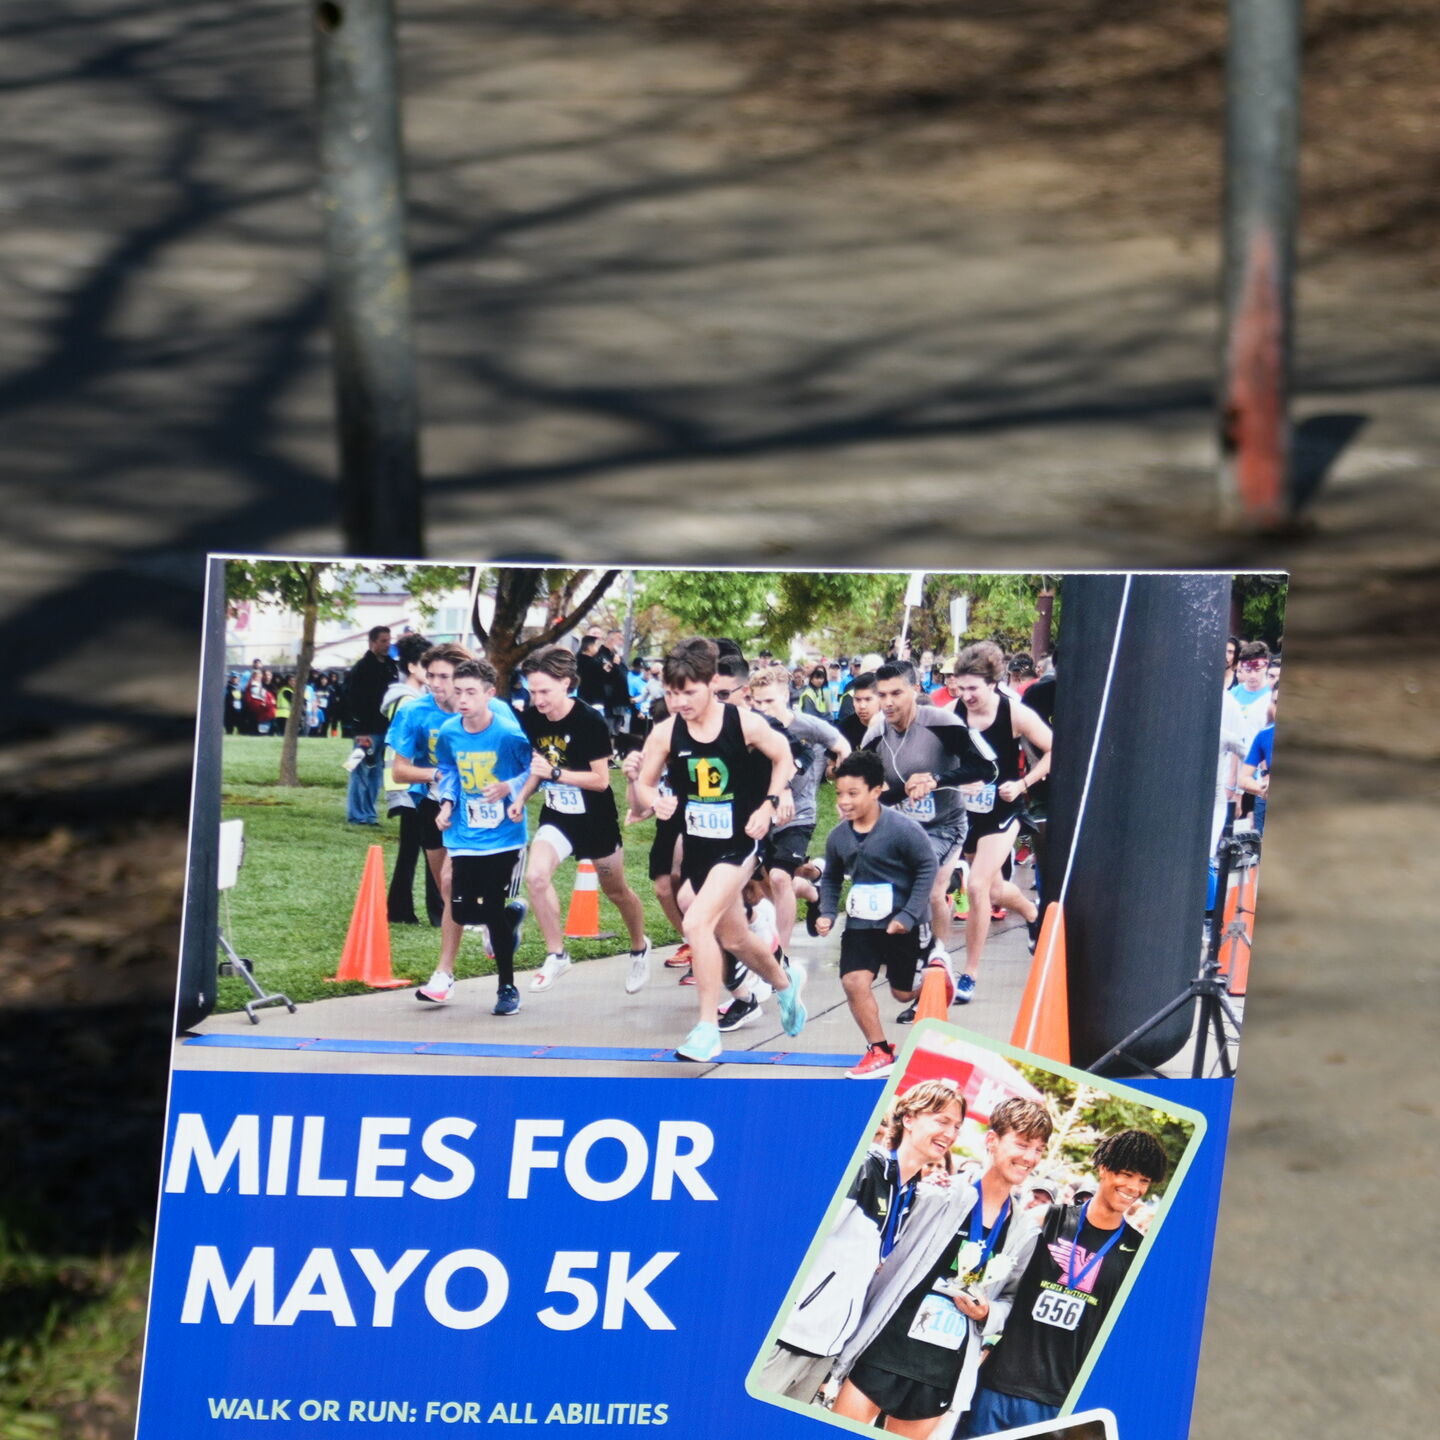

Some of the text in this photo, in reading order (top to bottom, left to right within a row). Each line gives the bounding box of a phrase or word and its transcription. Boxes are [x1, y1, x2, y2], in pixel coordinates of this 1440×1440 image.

[480, 804, 498, 819] 55
[560, 791, 578, 805] 53
[698, 813, 729, 829] 100
[164, 1112, 718, 1201] MILES FOR
[181, 1245, 680, 1330] MAYO 5K
[1036, 1294, 1080, 1326] 556
[208, 1398, 668, 1425] WALK OR RUN: FOR ALL ABILITIES
